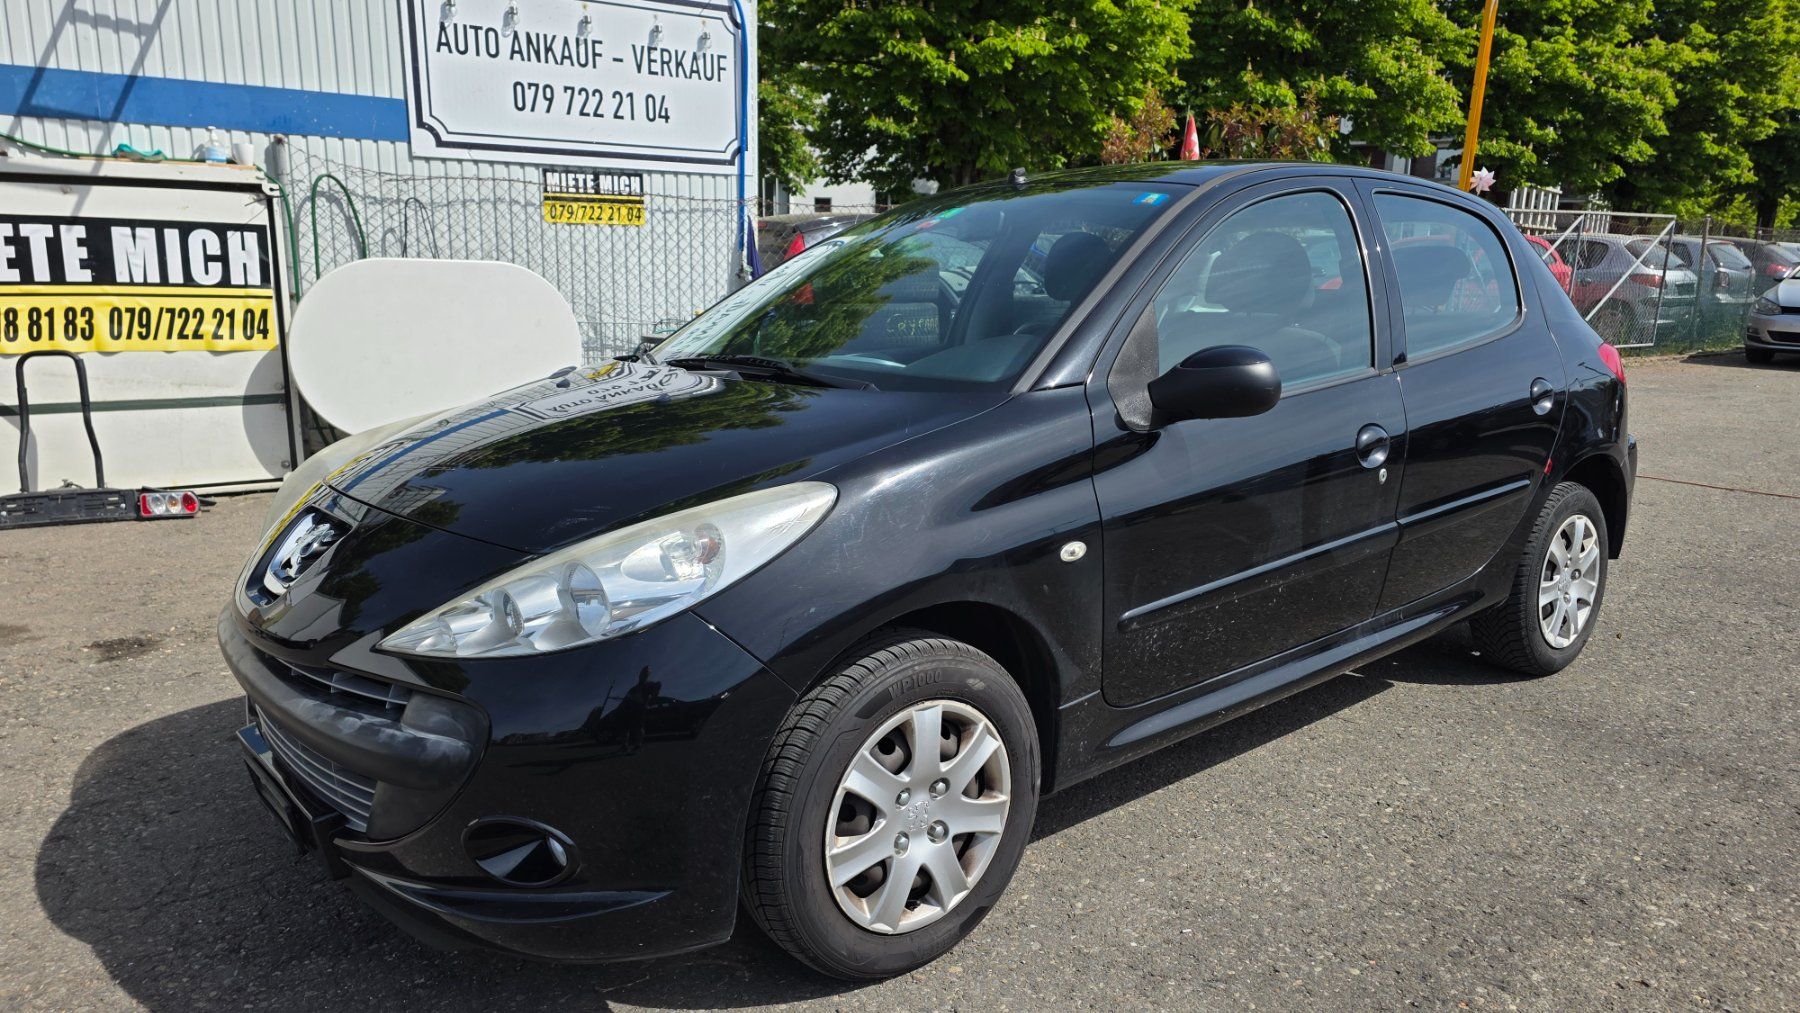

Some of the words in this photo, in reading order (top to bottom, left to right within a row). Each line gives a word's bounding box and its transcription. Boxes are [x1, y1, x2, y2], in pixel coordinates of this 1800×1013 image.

[436, 21, 500, 59] AUTO
[509, 30, 603, 69] ANKAUF
[631, 44, 727, 82] VERKAUF
[513, 81, 555, 113] 079
[563, 85, 605, 118] 722
[612, 90, 635, 121] 21
[645, 93, 670, 123] 04
[545, 171, 595, 193] MIETE
[599, 174, 641, 195] MICH
[550, 204, 603, 220] 079/722
[608, 206, 621, 221] 21
[627, 207, 641, 222] 04
[111, 226, 261, 286] MICH
[0, 307, 19, 342] 8
[28, 306, 55, 342] 81
[64, 306, 94, 341] 83
[109, 306, 205, 341] 079/722
[211, 307, 236, 340] 21
[242, 308, 269, 341] 04
